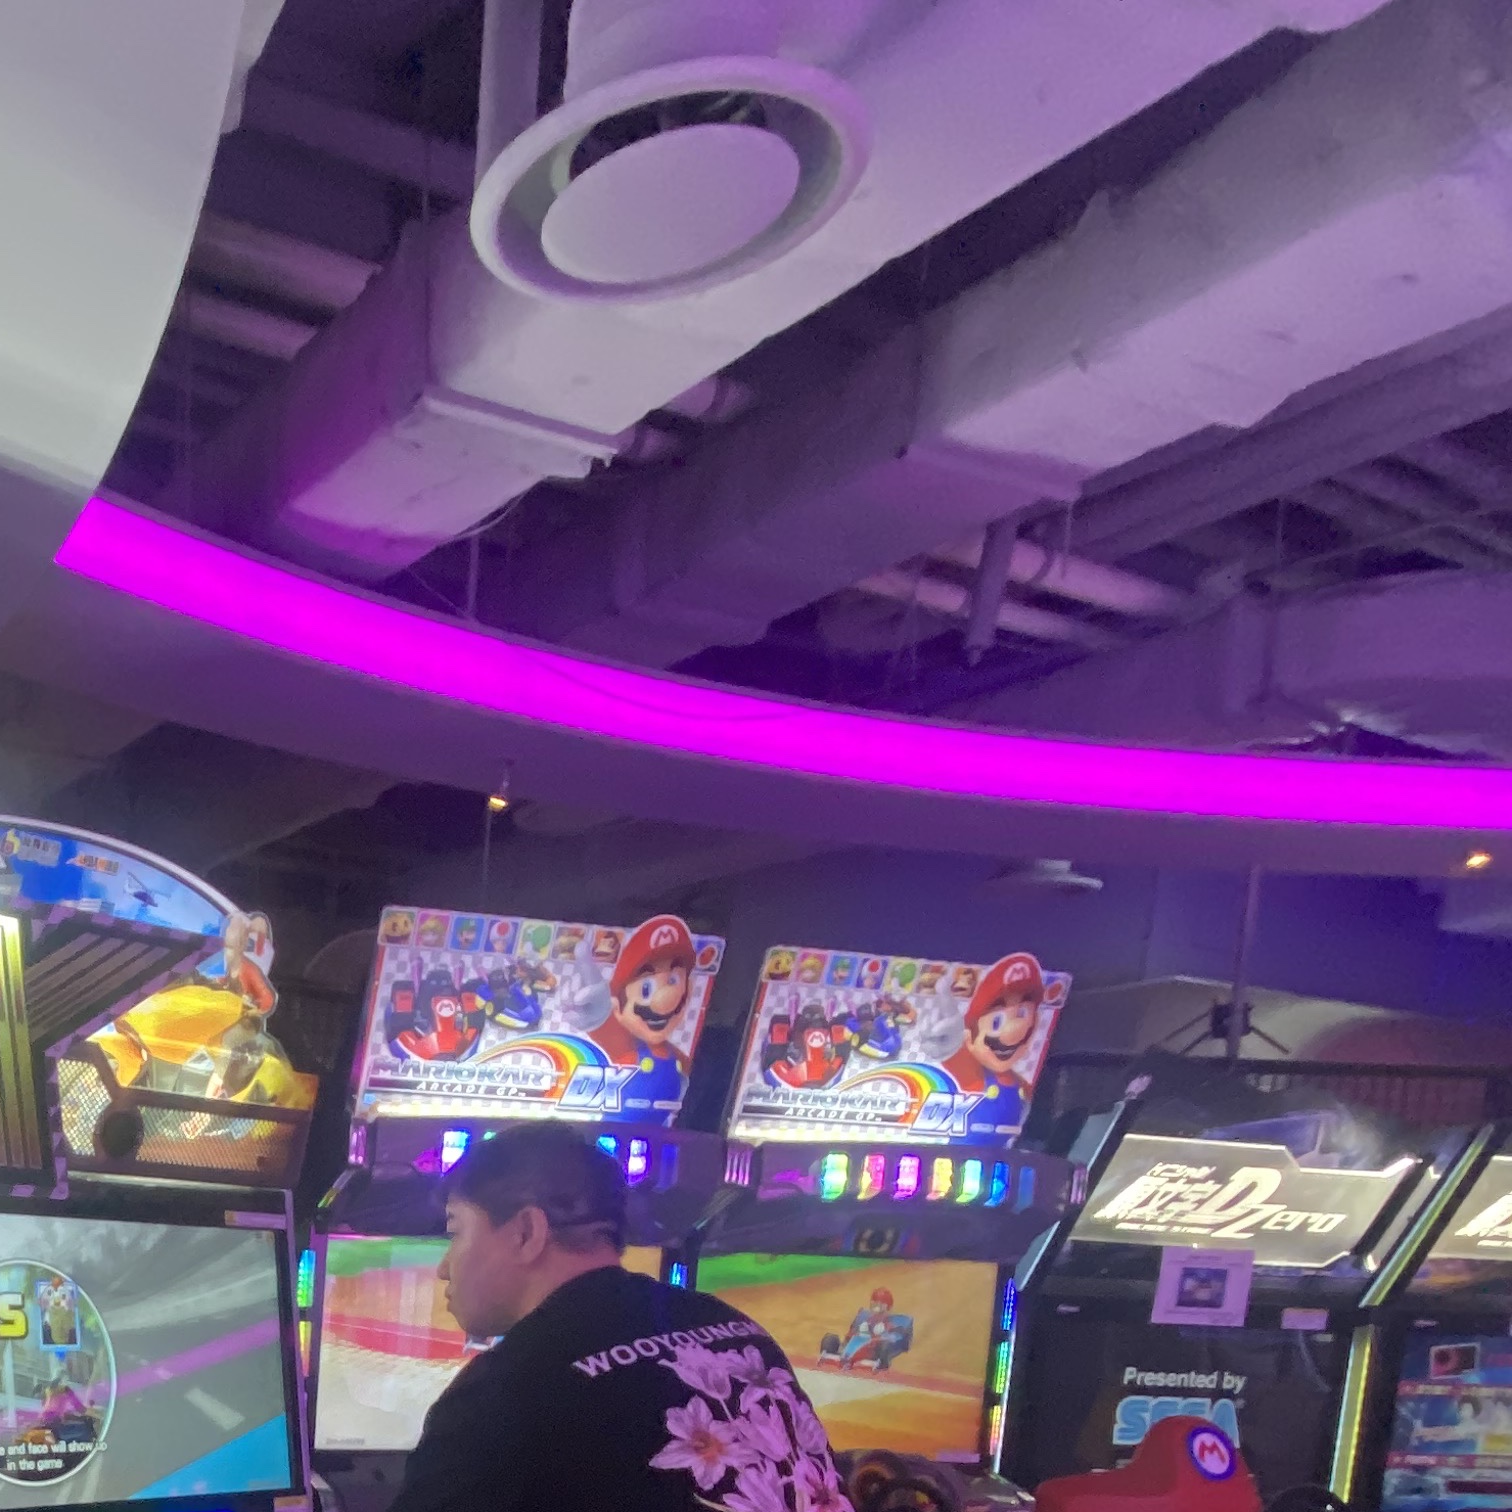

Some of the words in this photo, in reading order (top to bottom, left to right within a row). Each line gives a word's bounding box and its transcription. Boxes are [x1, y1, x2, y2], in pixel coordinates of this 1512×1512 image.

[416, 1082, 485, 1096] ARCADE
[557, 1063, 640, 1112] DX
[784, 1107, 846, 1120] ARCADE
[909, 1090, 987, 1136] DX
[1122, 1366, 1217, 1389] Presented
[1222, 1371, 1247, 1395] by
[8, 1443, 25, 1456] and
[28, 1442, 48, 1455] face
[51, 1440, 67, 1453] will
[68, 1440, 93, 1453] show
[6, 1459, 17, 1472] in
[19, 1458, 36, 1472] the
[37, 1459, 64, 1473] game
